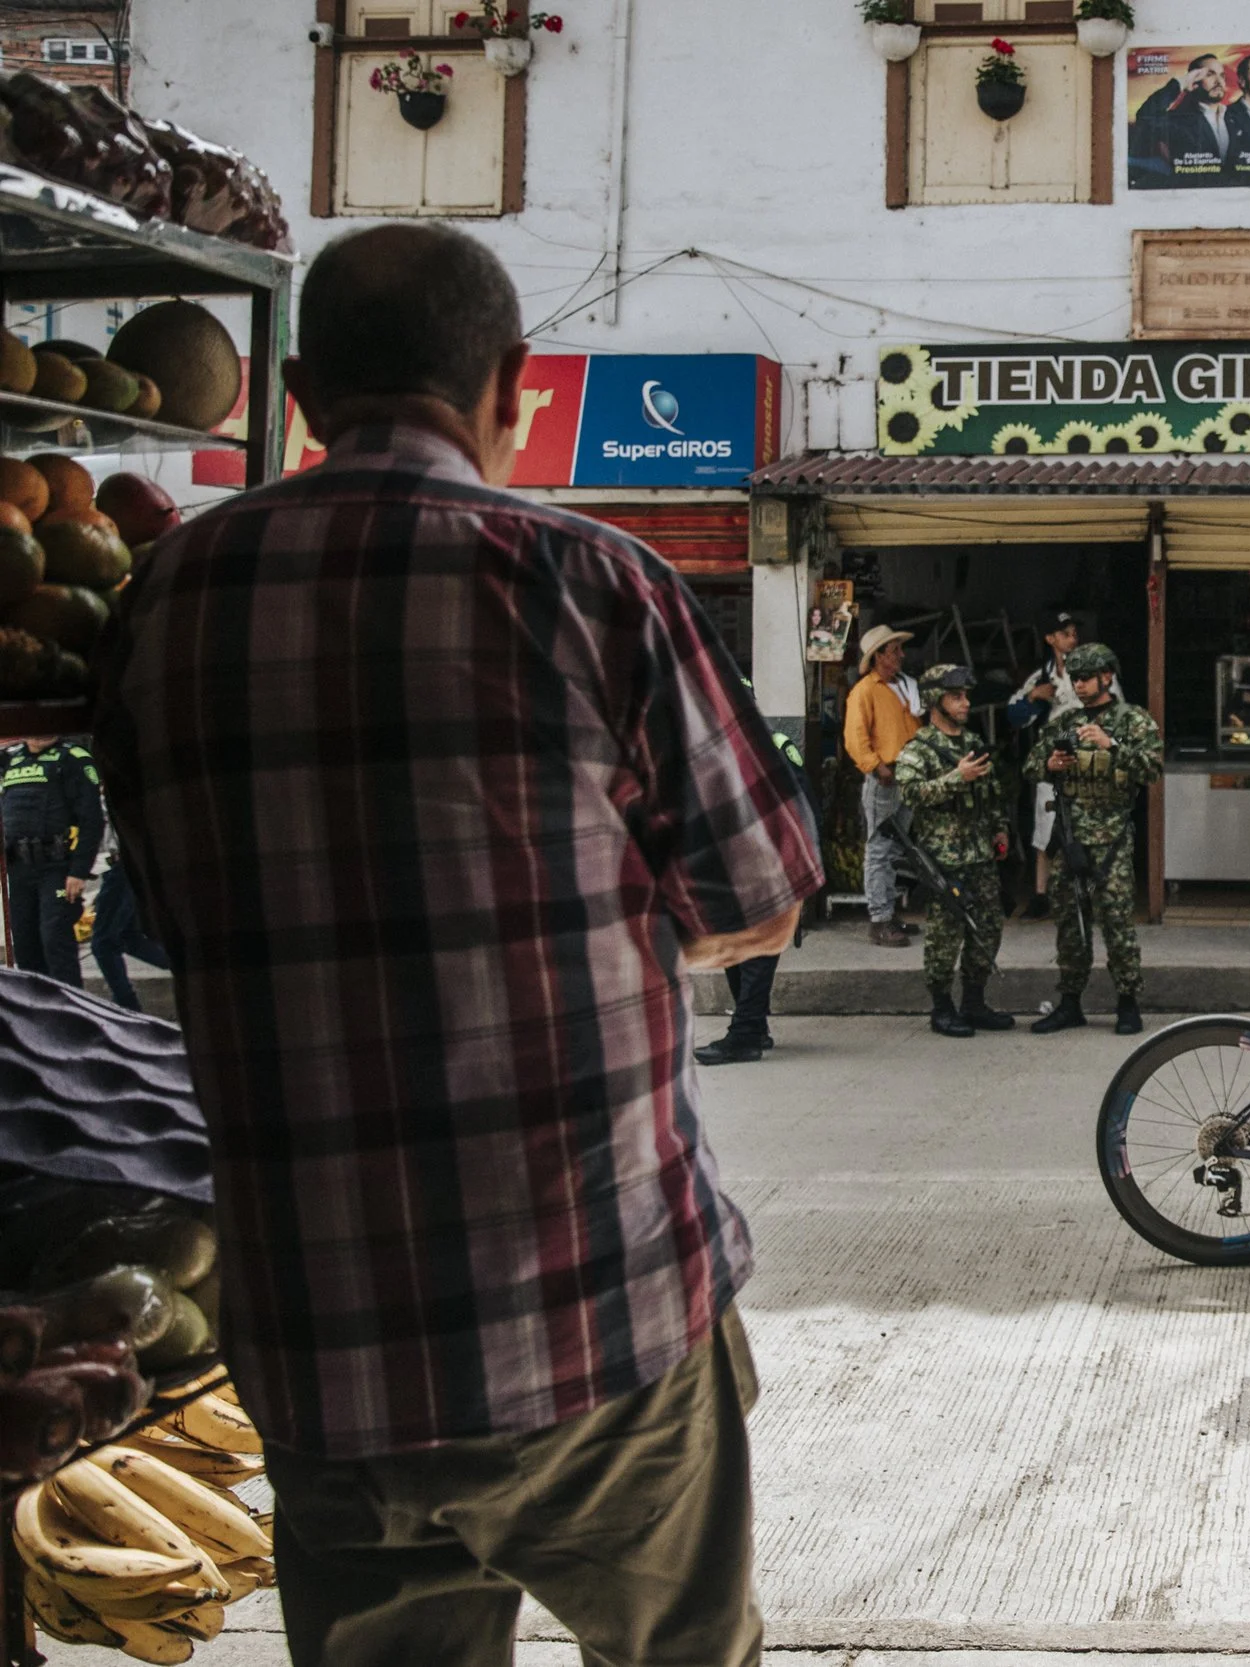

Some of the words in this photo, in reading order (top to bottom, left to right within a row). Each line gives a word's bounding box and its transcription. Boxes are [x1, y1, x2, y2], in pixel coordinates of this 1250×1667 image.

[1175, 165, 1221, 173] Presidente
[930, 354, 1163, 405] TIENDA
[603, 441, 665, 461] Super
[667, 441, 732, 457] GIROS
